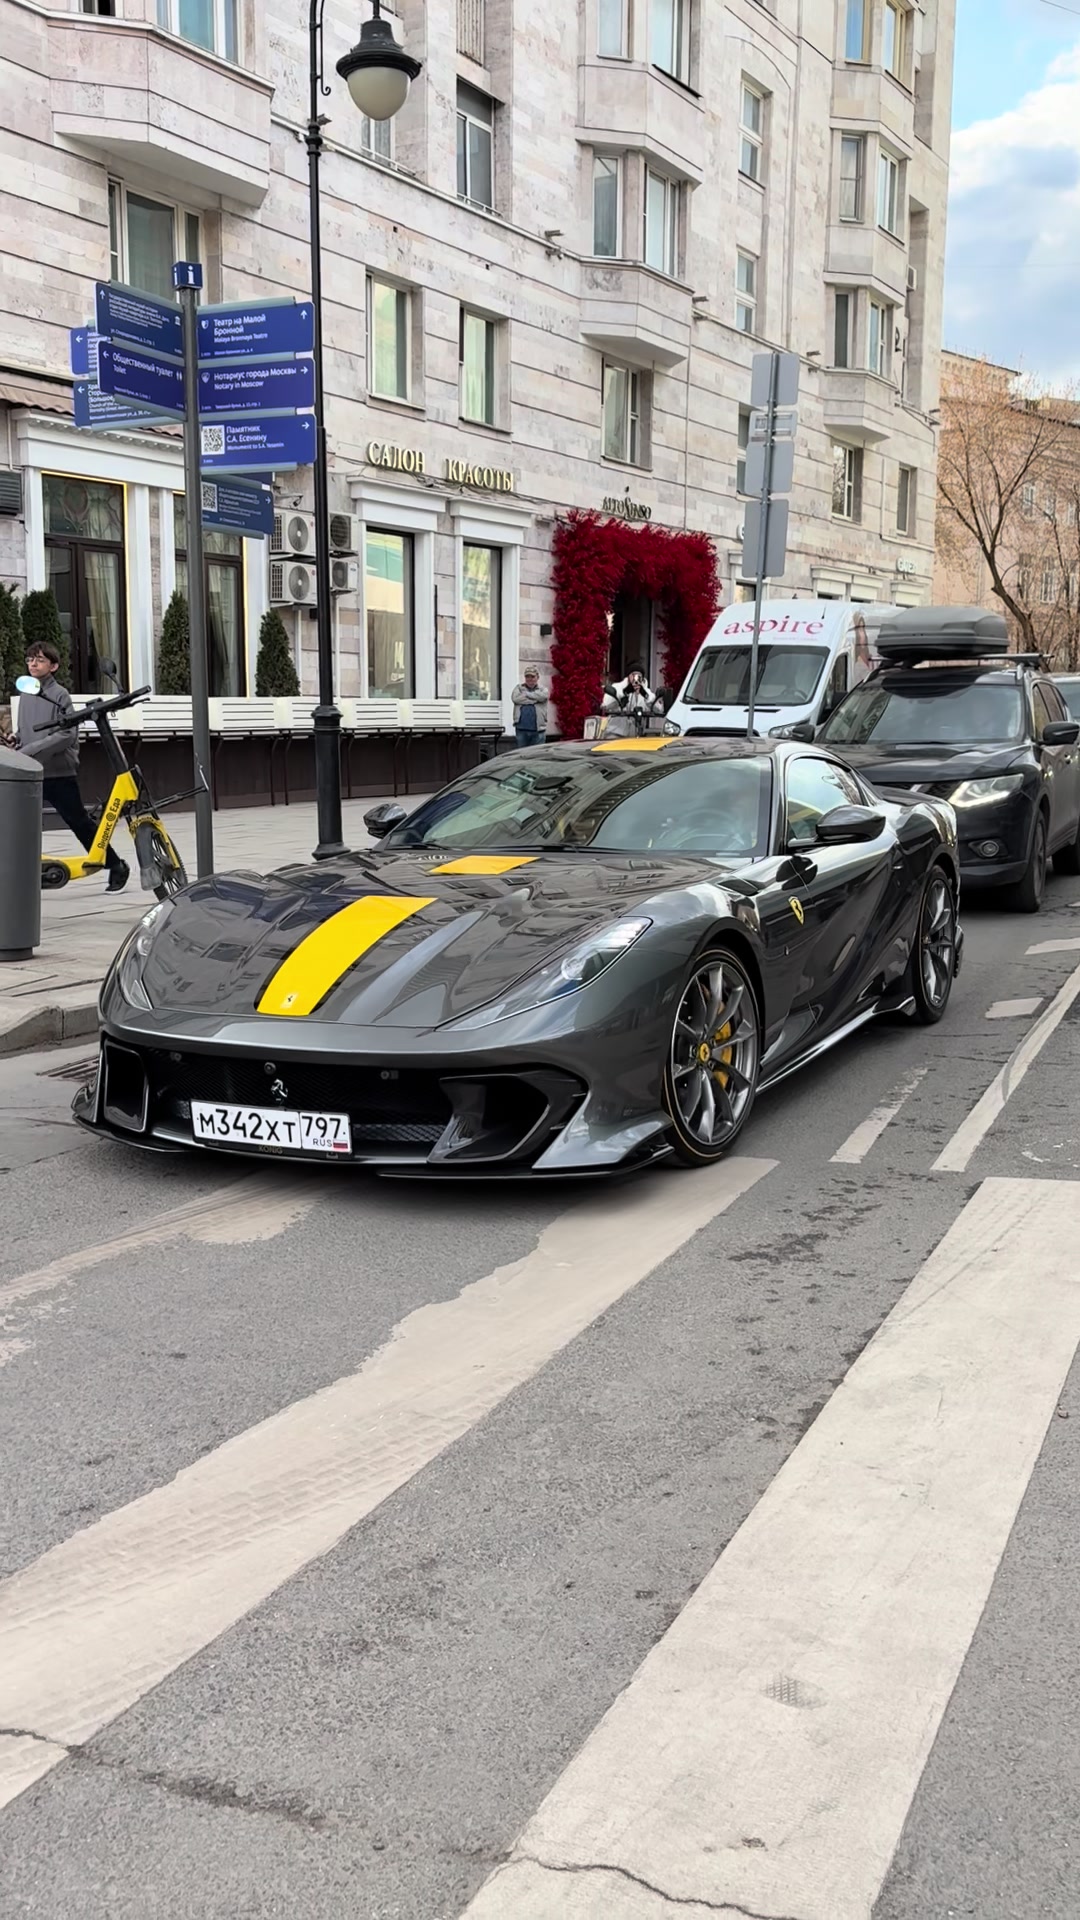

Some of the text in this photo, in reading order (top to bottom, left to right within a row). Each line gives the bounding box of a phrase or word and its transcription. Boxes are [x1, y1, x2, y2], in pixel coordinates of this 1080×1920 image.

[213, 318, 232, 327] Театр
[243, 314, 266, 324] Малой
[214, 326, 244, 336] Бронной
[112, 352, 174, 378] Общественный туалет
[113, 364, 127, 375] Toilet
[214, 367, 297, 381] Нотариус города Москвы
[214, 382, 234, 391] Notary
[241, 380, 264, 388] Moscow
[227, 425, 260, 434] Памятник
[239, 434, 267, 443] Есенину
[367, 440, 515, 493] САЛОН КРАСОТЫ
[723, 615, 824, 635] aspire
[97, 797, 121, 850] Яндекс Еда
[301, 1115, 341, 1139] 797
[312, 1138, 333, 1148] RUS
